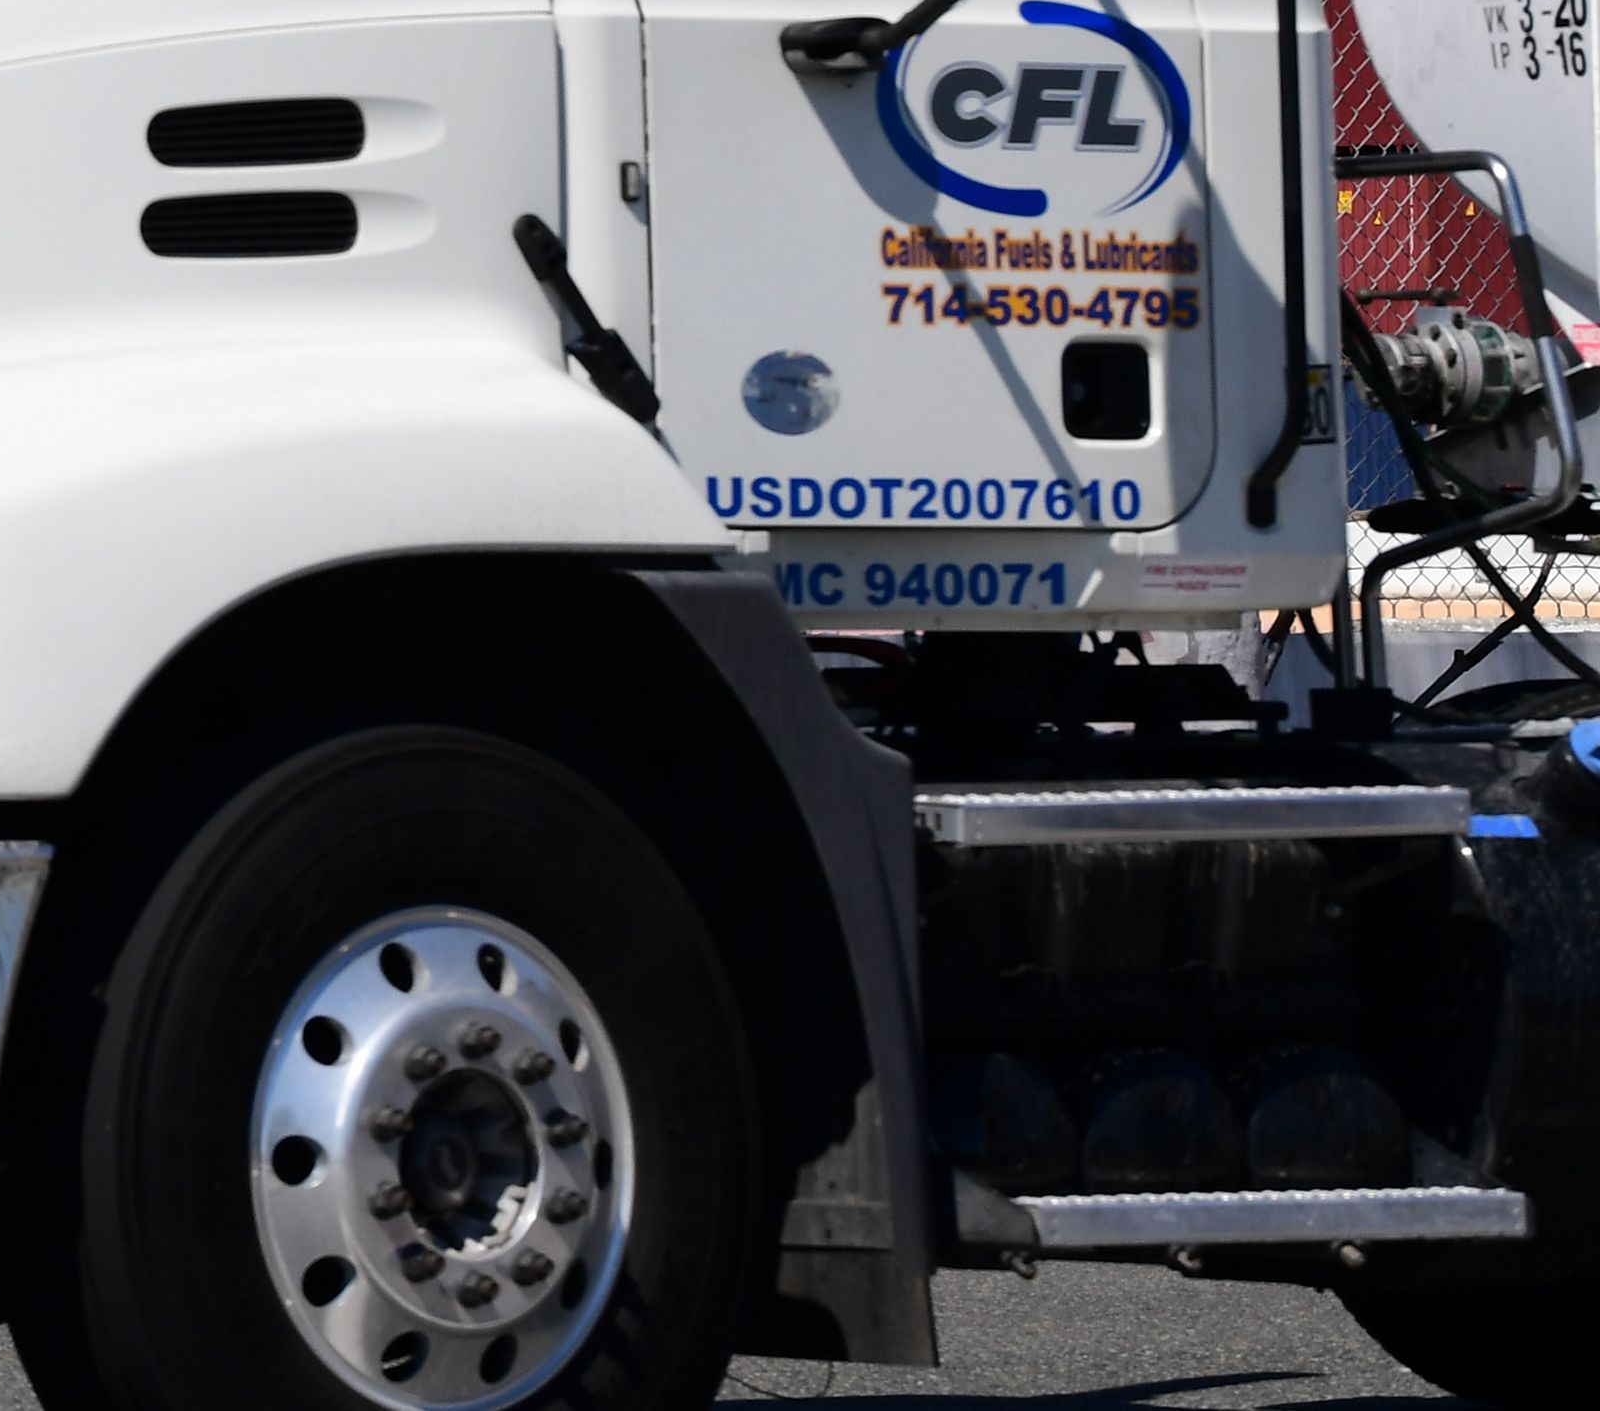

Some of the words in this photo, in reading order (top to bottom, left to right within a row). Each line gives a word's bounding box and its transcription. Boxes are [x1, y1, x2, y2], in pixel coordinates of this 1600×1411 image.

[927, 60, 1147, 153] CFL
[880, 227, 988, 273] California
[994, 231, 1054, 273] Fuels
[1060, 233, 1076, 269] &
[1081, 231, 1201, 276] Lubricants
[880, 283, 1202, 330] 714-530-4795
[706, 474, 1142, 522] USDOT2007610
[865, 562, 1068, 608] 940071
